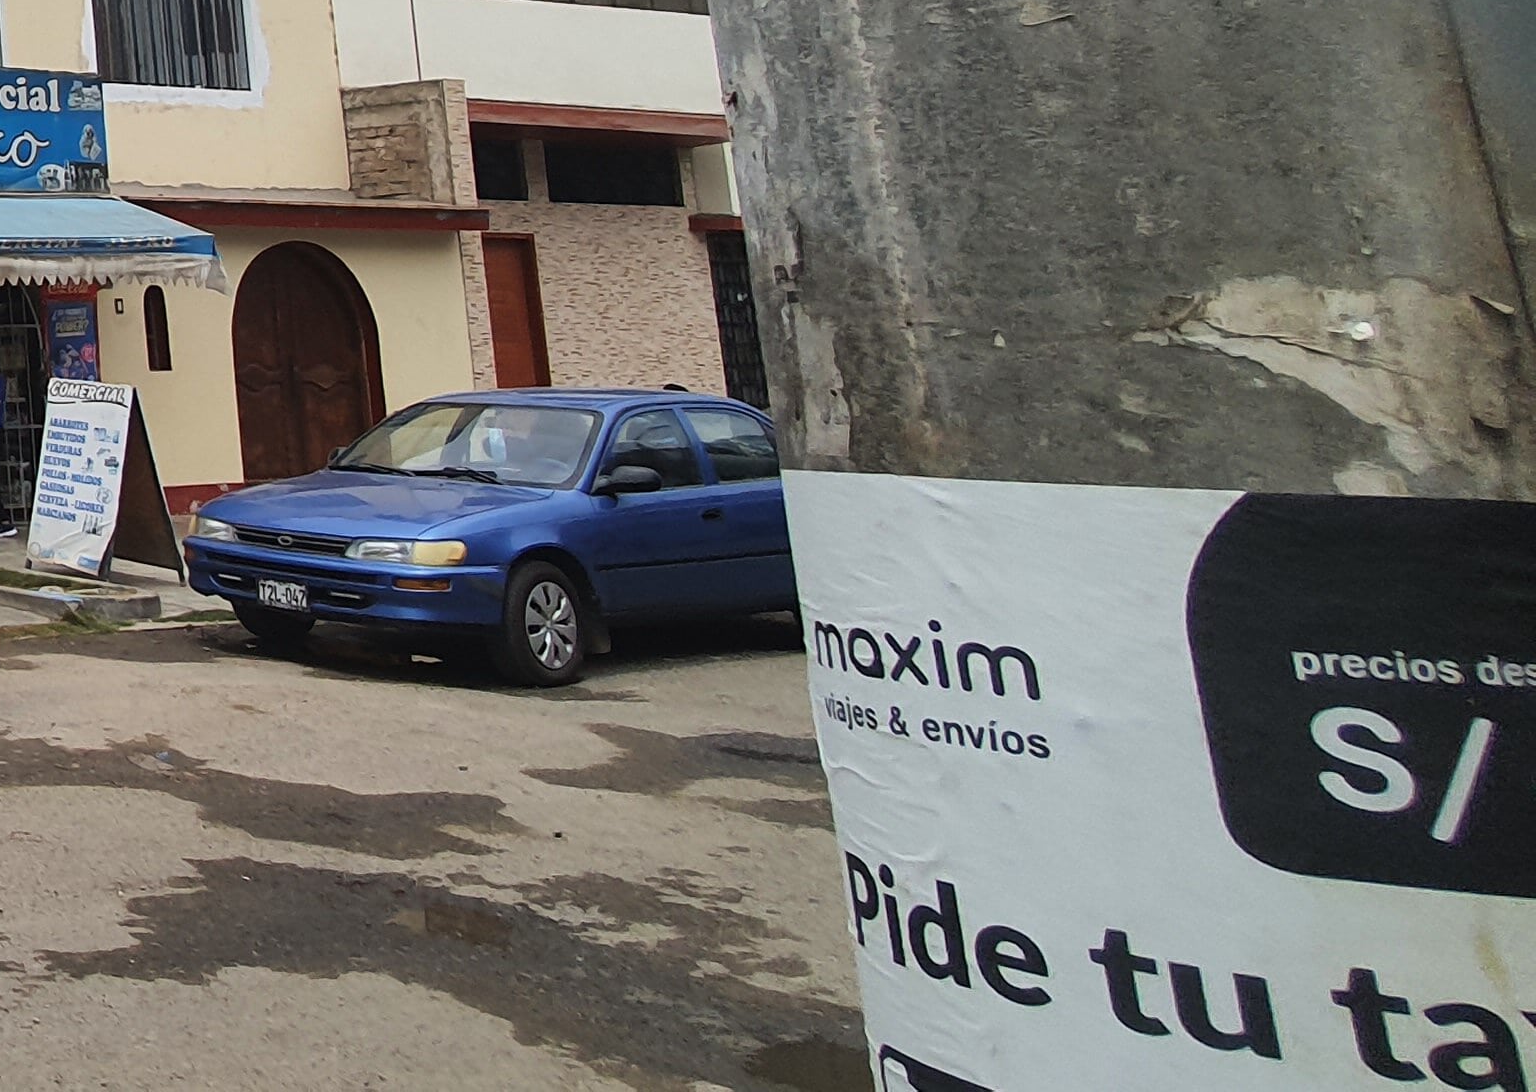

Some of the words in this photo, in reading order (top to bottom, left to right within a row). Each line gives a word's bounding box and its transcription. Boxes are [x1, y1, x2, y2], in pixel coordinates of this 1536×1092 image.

[49, 380, 126, 404] COMERCIAL
[814, 619, 1040, 701] maxim
[1291, 650, 1466, 684] precios
[824, 692, 878, 730] viajes
[888, 706, 910, 737] &
[922, 719, 1050, 758] envíos
[1310, 706, 1495, 842] S/
[845, 851, 1052, 1006] Pide
[1089, 928, 1284, 1061] tu
[1330, 967, 1536, 1092] ta
